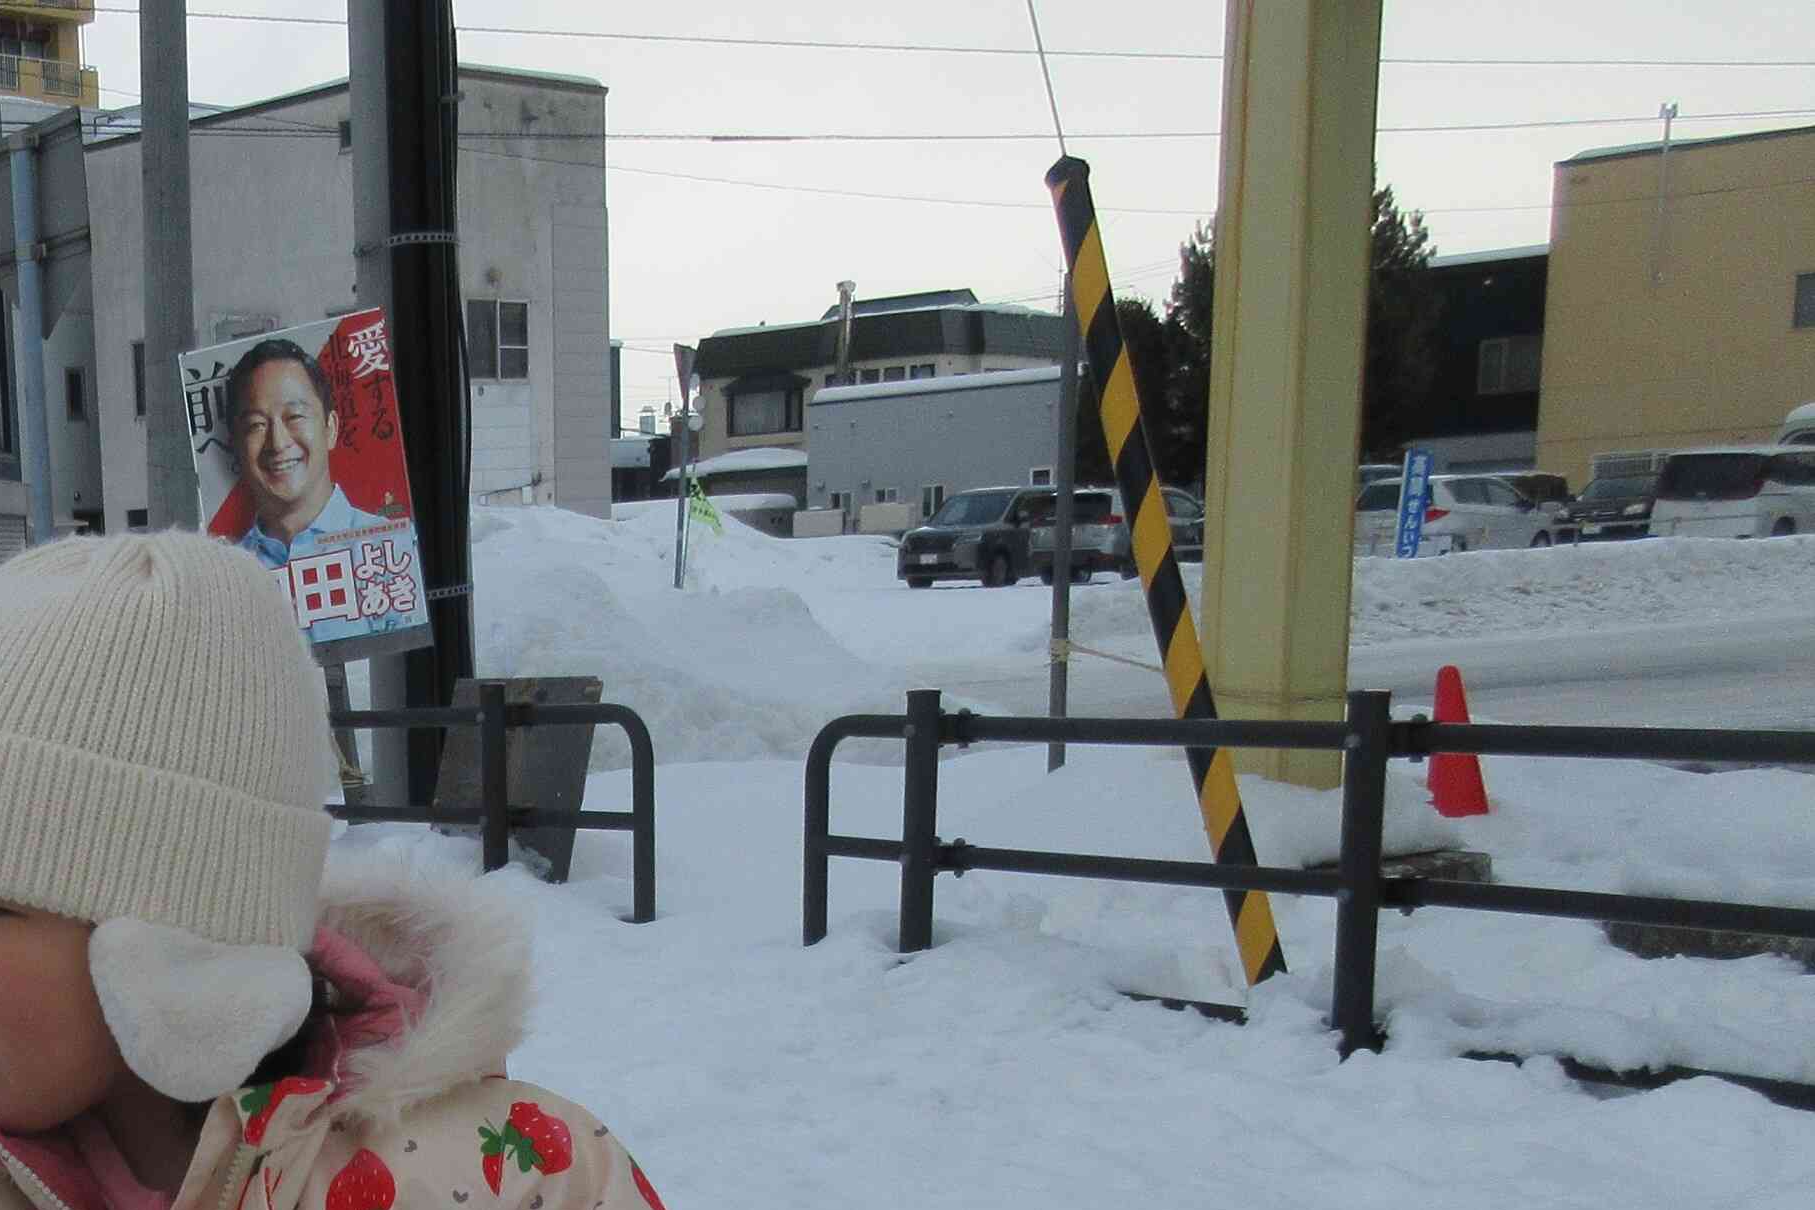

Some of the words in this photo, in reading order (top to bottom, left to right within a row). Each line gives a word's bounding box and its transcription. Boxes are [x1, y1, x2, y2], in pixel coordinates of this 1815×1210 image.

[186, 361, 235, 454] 前へ
[347, 319, 394, 440] 愛する
